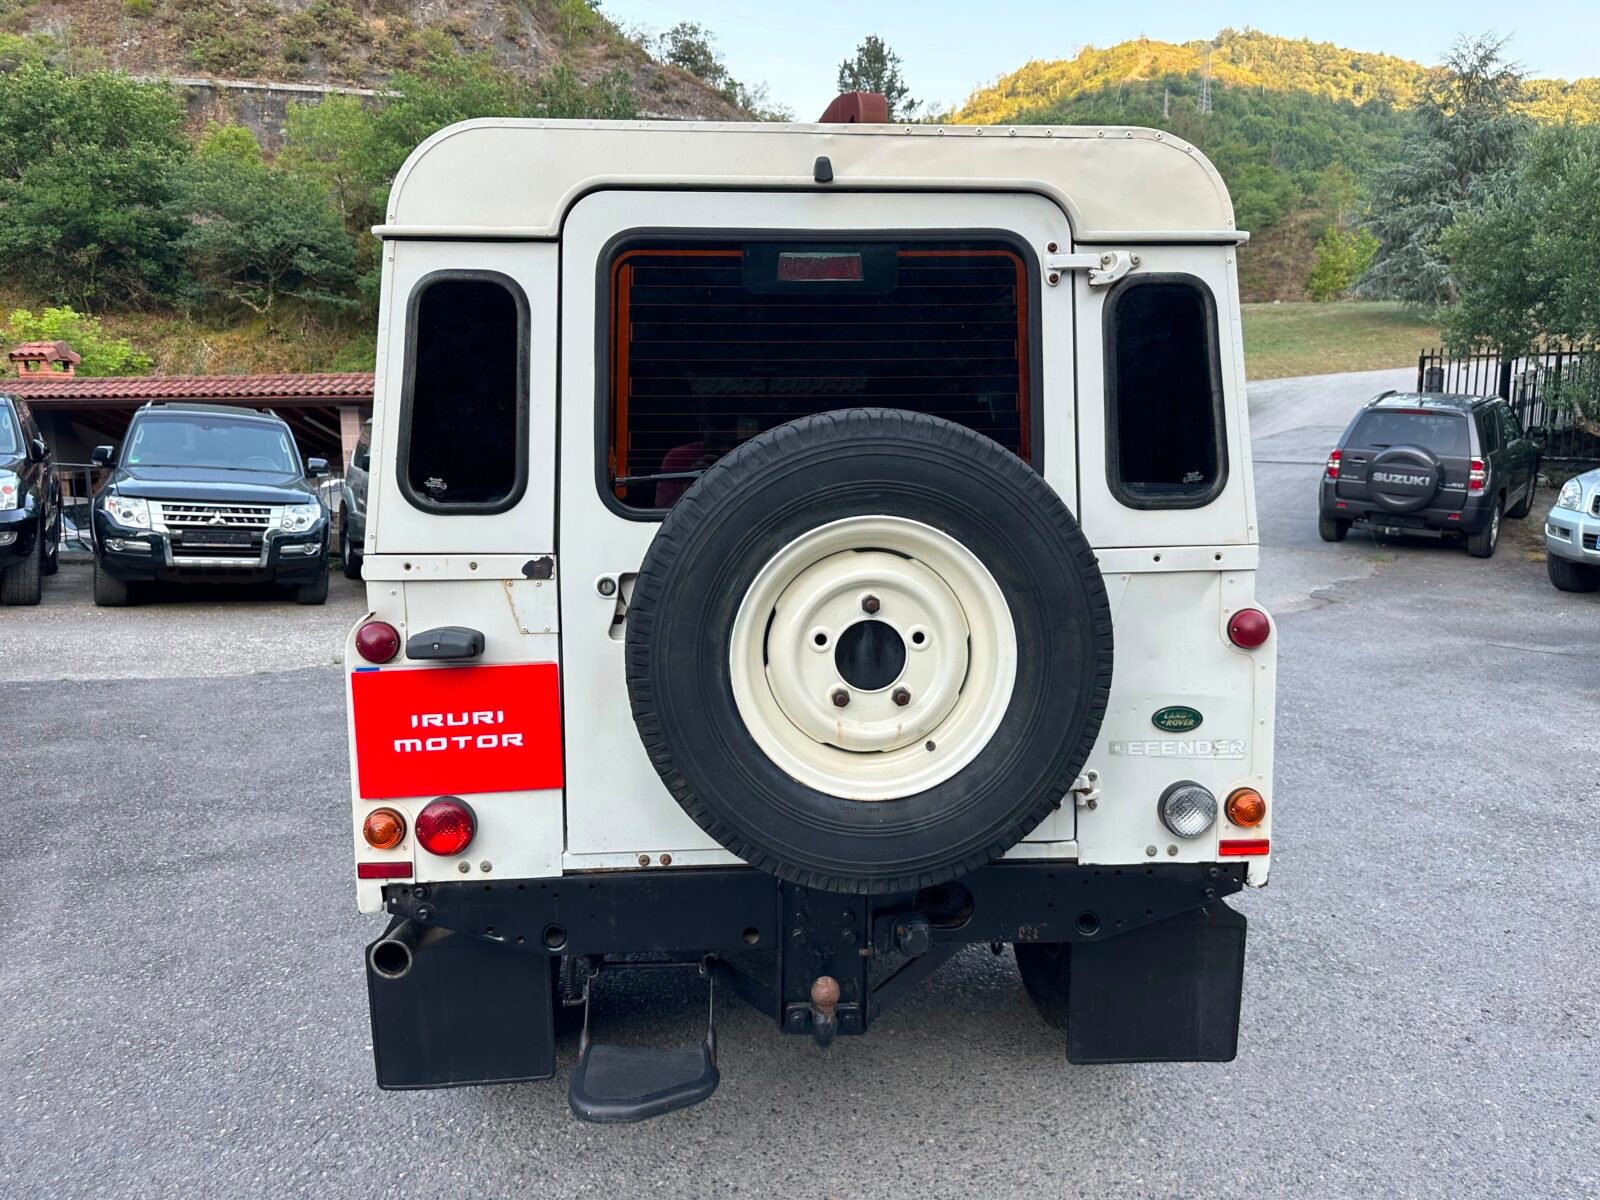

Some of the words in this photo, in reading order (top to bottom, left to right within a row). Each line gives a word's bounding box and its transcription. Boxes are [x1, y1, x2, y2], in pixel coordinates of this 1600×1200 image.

[1372, 472, 1430, 485] SUZUKI
[410, 711, 504, 728] IRURI
[1164, 711, 1188, 719] LAND
[394, 733, 524, 752] MOTOR
